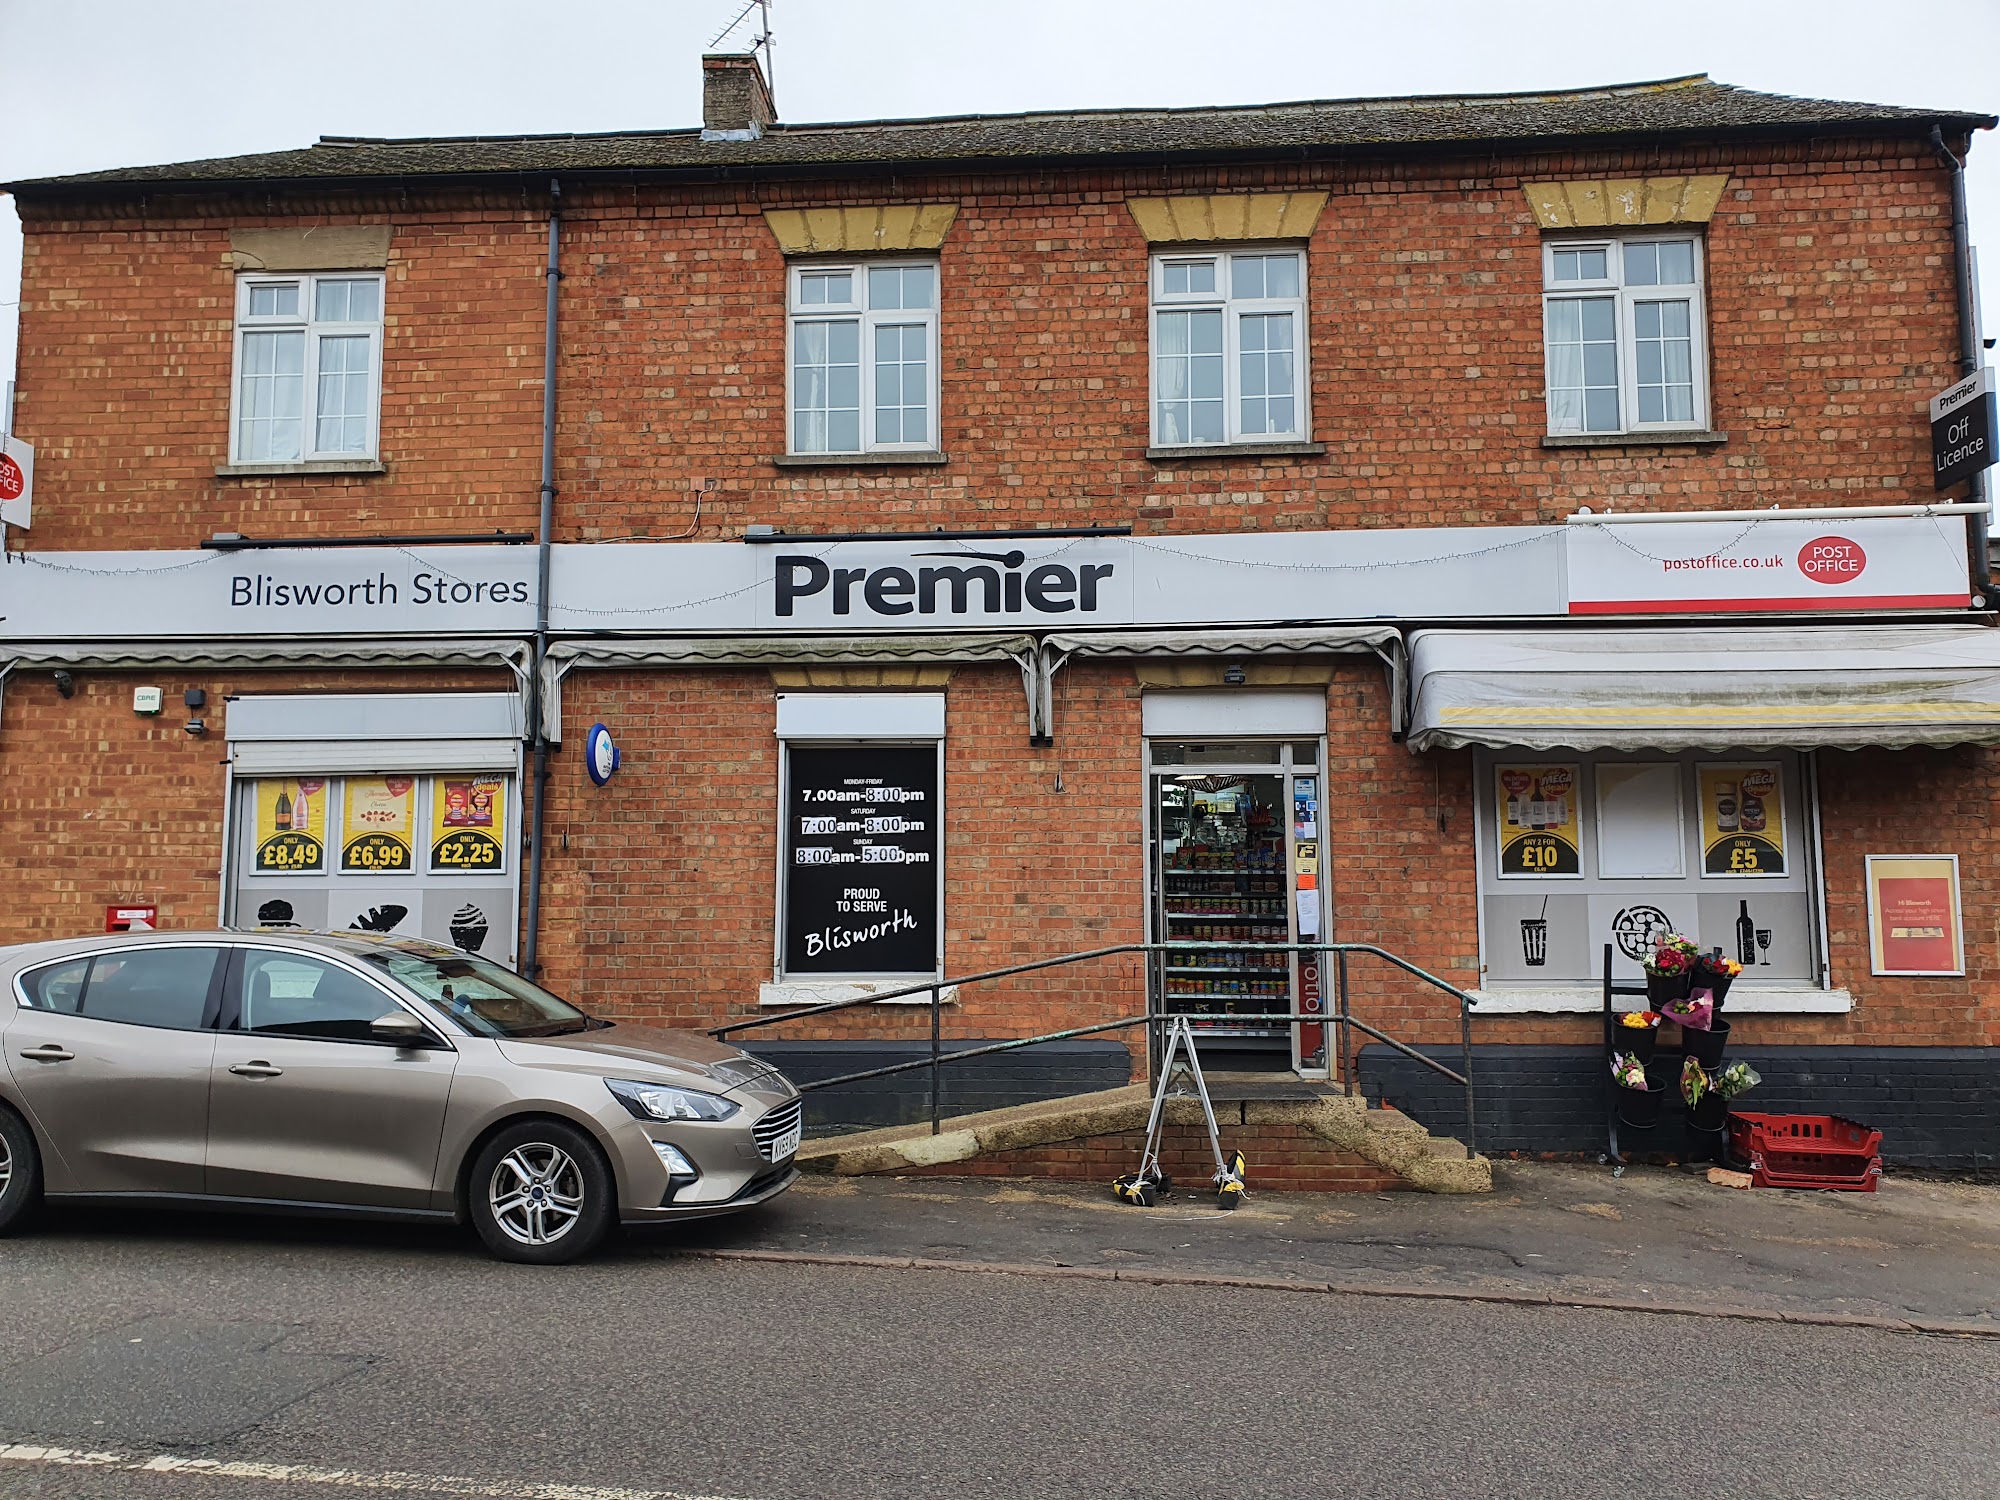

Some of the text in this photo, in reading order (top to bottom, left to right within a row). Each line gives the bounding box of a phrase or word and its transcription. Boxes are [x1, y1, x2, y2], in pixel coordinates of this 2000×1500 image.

[1940, 381, 1977, 410] Premier
[1948, 416, 1969, 444] Off
[1937, 437, 1984, 471] Licence
[0, 461, 16, 478] OST
[1813, 546, 1852, 559] POST
[1664, 555, 1784, 572] postoffice.co.uk
[1804, 559, 1859, 573] OFFICE
[231, 573, 528, 606] Blisworth Stores
[775, 550, 1114, 616] Premier
[472, 773, 502, 785] MEGA
[1540, 773, 1573, 786] MEGA
[1743, 774, 1775, 787] MEGA
[264, 844, 318, 865] £8.49
[349, 845, 403, 866] £6.99
[440, 843, 494, 863] £2.25
[1522, 846, 1558, 867] £10
[1731, 848, 1758, 868] £5
[843, 888, 881, 900] PROUD
[836, 901, 888, 912] TO SERVE
[804, 908, 918, 957] Blisworth
